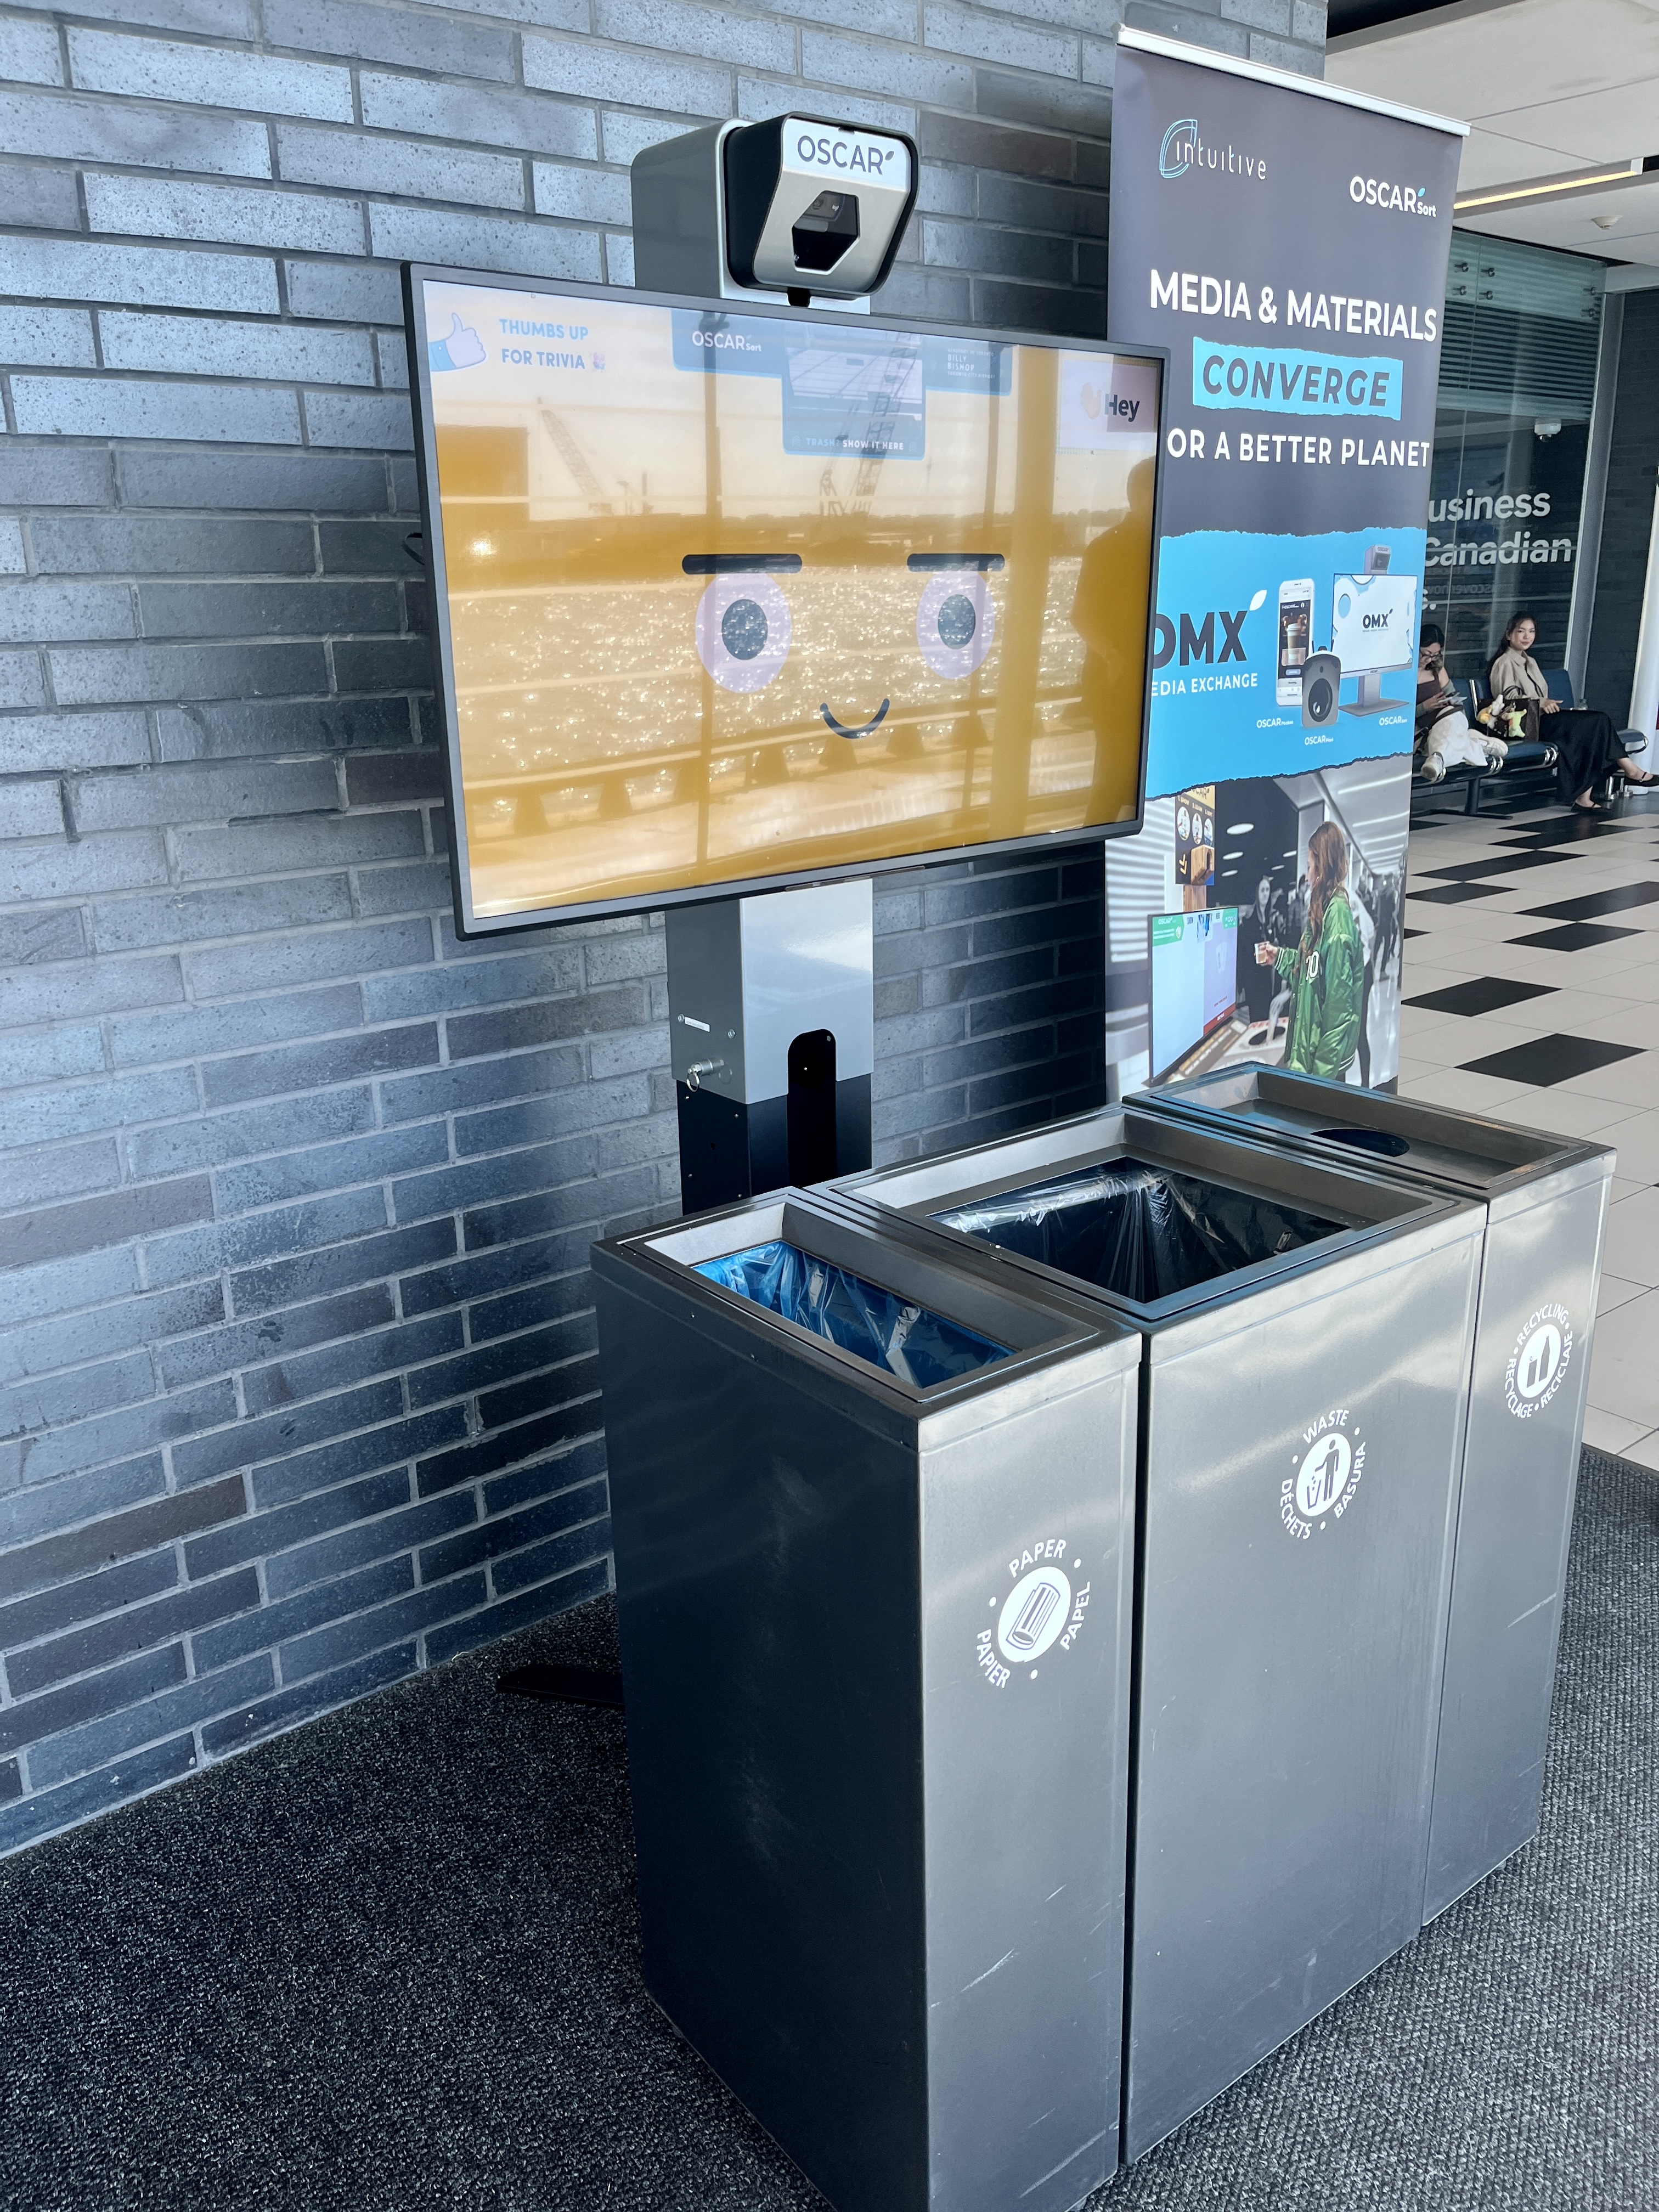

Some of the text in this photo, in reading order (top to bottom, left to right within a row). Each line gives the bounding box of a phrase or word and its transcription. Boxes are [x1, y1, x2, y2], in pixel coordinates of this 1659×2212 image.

[797, 135, 883, 175] OSCAR
[1150, 269, 1437, 342] MEDIA & MATERIALS
[499, 319, 588, 340] THUMBS UP
[501, 348, 585, 369] FOR TRIVIA
[947, 354, 967, 362] BILLY
[947, 362, 974, 371] BISHOP
[1203, 355, 1390, 407] CONVERGE
[1104, 393, 1140, 422] Hey
[843, 439, 868, 448] SHOW
[872, 441, 879, 449] IT
[882, 441, 904, 450] HERE
[1167, 428, 1430, 467] OR A BETTER PLANET
[1429, 489, 1550, 522] usiness
[1425, 531, 1572, 567] Canadian
[1363, 614, 1389, 628] OMX
[1152, 673, 1258, 696] EDIA EXCHANGE
[1516, 1304, 1568, 1346] RECYCLING
[1505, 1358, 1533, 1418] RECYCLAGE
[1540, 1331, 1572, 1408] RECICLAJE
[1303, 1409, 1349, 1443] WASTE
[1334, 1442, 1366, 1518] BASURA
[1280, 1479, 1312, 1539] DÉCHETS
[1009, 1539, 1066, 1578] PAPER
[1060, 1581, 1090, 1650] PAPEL
[977, 1629, 1011, 1689] PAPIER
